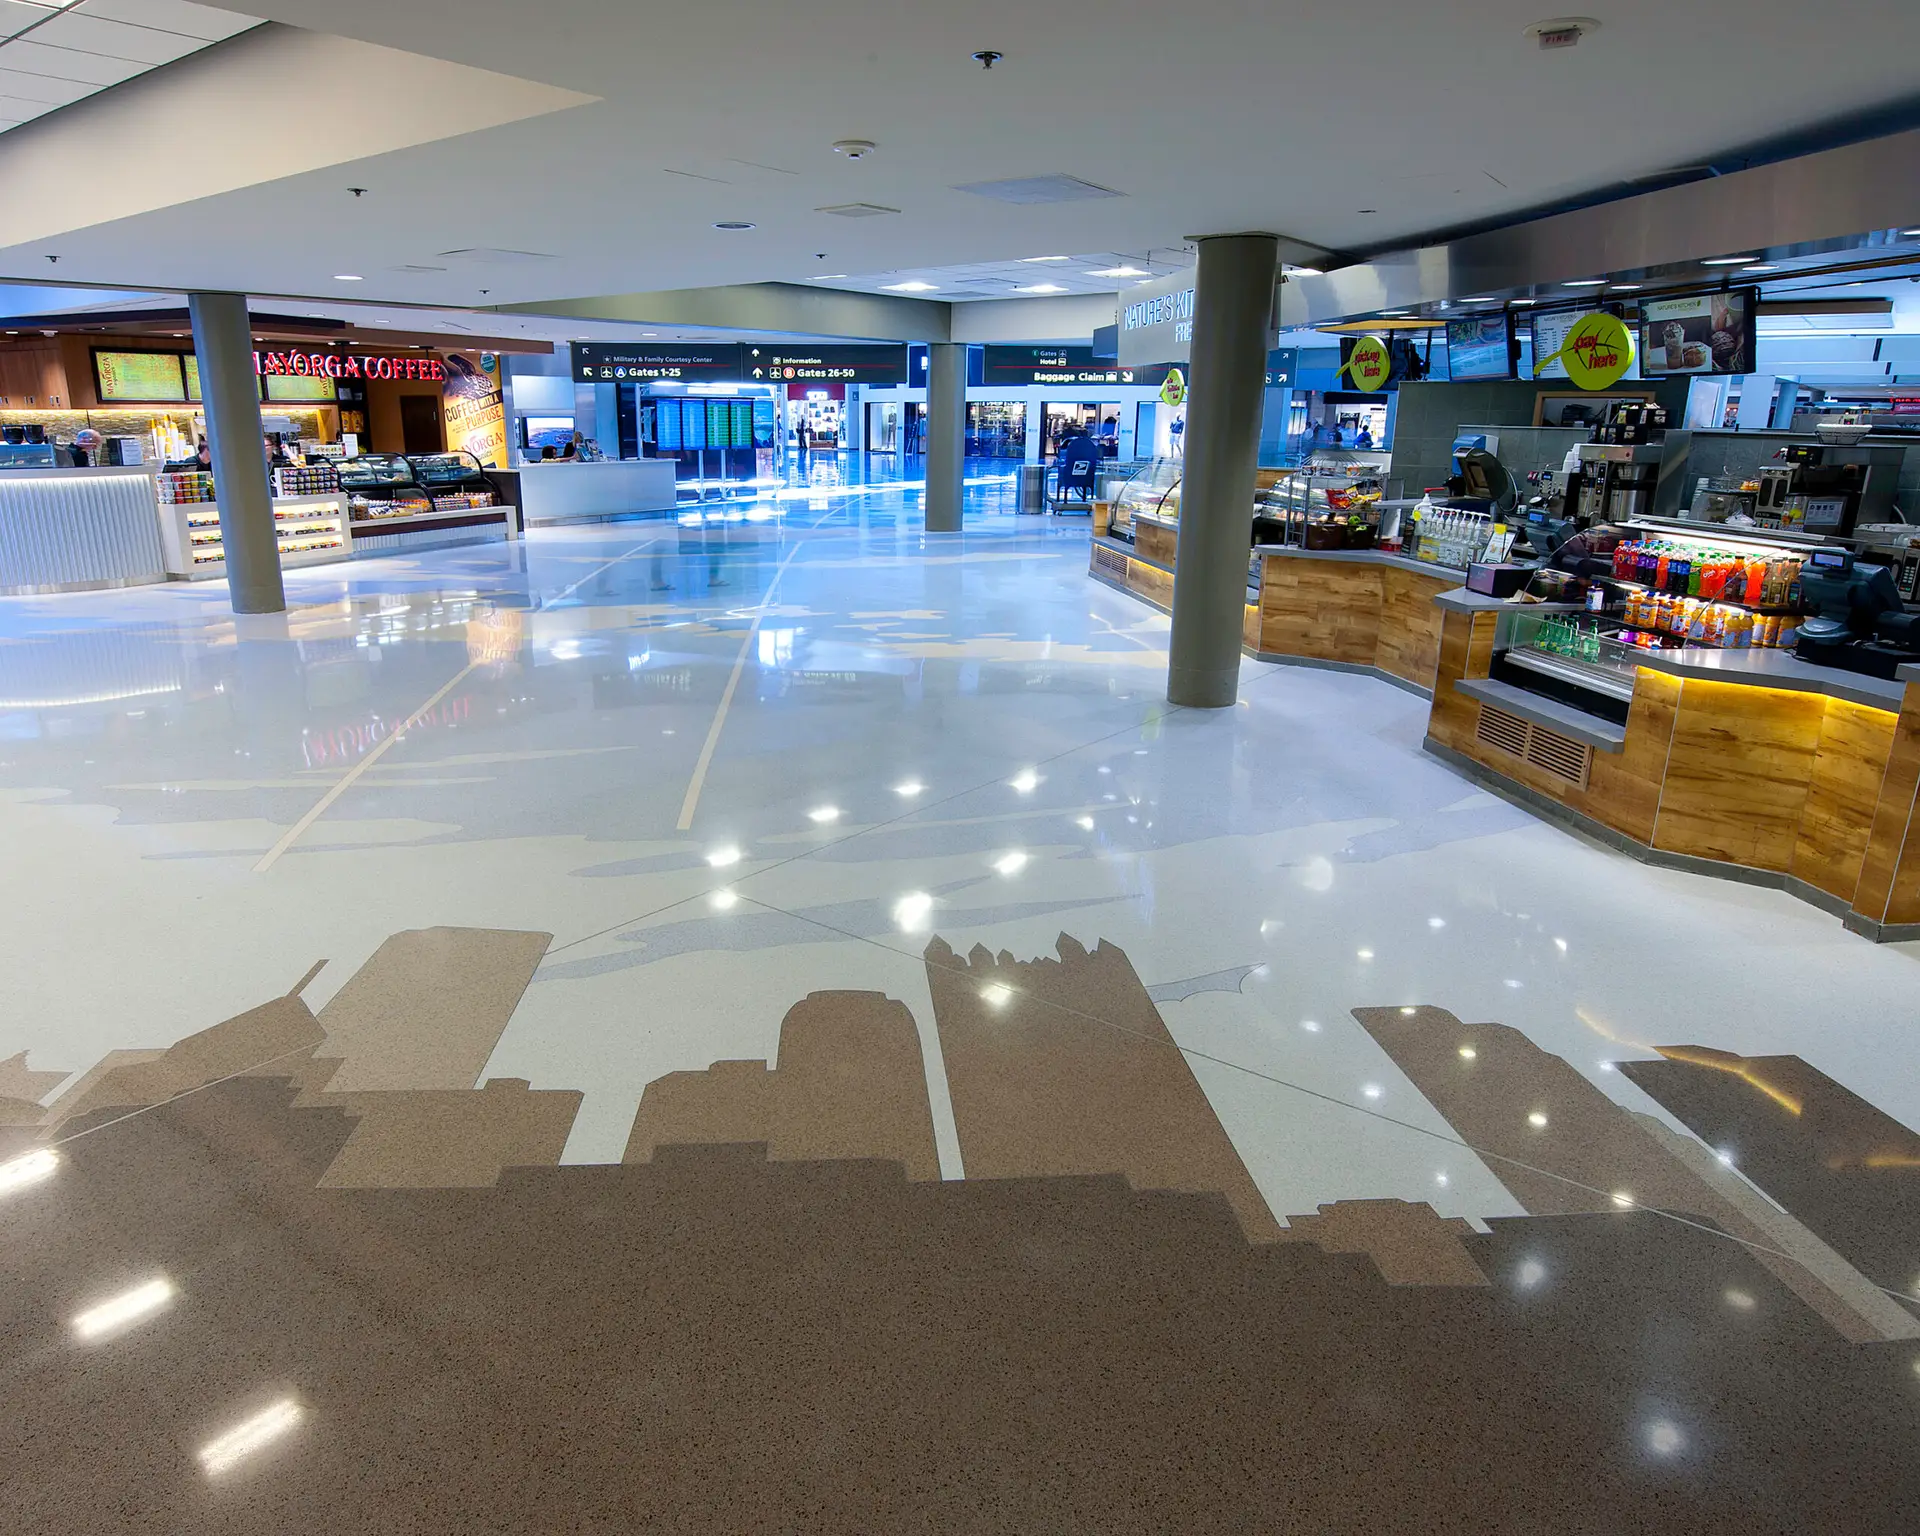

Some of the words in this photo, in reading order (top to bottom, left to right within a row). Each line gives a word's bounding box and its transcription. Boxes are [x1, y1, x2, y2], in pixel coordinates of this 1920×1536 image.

[1124, 294, 1173, 331] NATURE'S
[1176, 288, 1195, 319] KIT
[1175, 320, 1192, 342] FRE
[1574, 335, 1598, 353] pay
[364, 356, 443, 380] COFFEE
[645, 356, 664, 364] Family
[1588, 354, 1617, 369] here
[629, 368, 659, 377] Gates
[661, 368, 681, 377] 1-25
[797, 369, 826, 377] Gates
[828, 369, 855, 377] 26-50
[1034, 372, 1075, 383] Baggage
[1078, 372, 1104, 382] Claim
[445, 400, 480, 422] COFFEE
[465, 405, 502, 430] PURPOSE
[461, 432, 504, 453] YORGA
